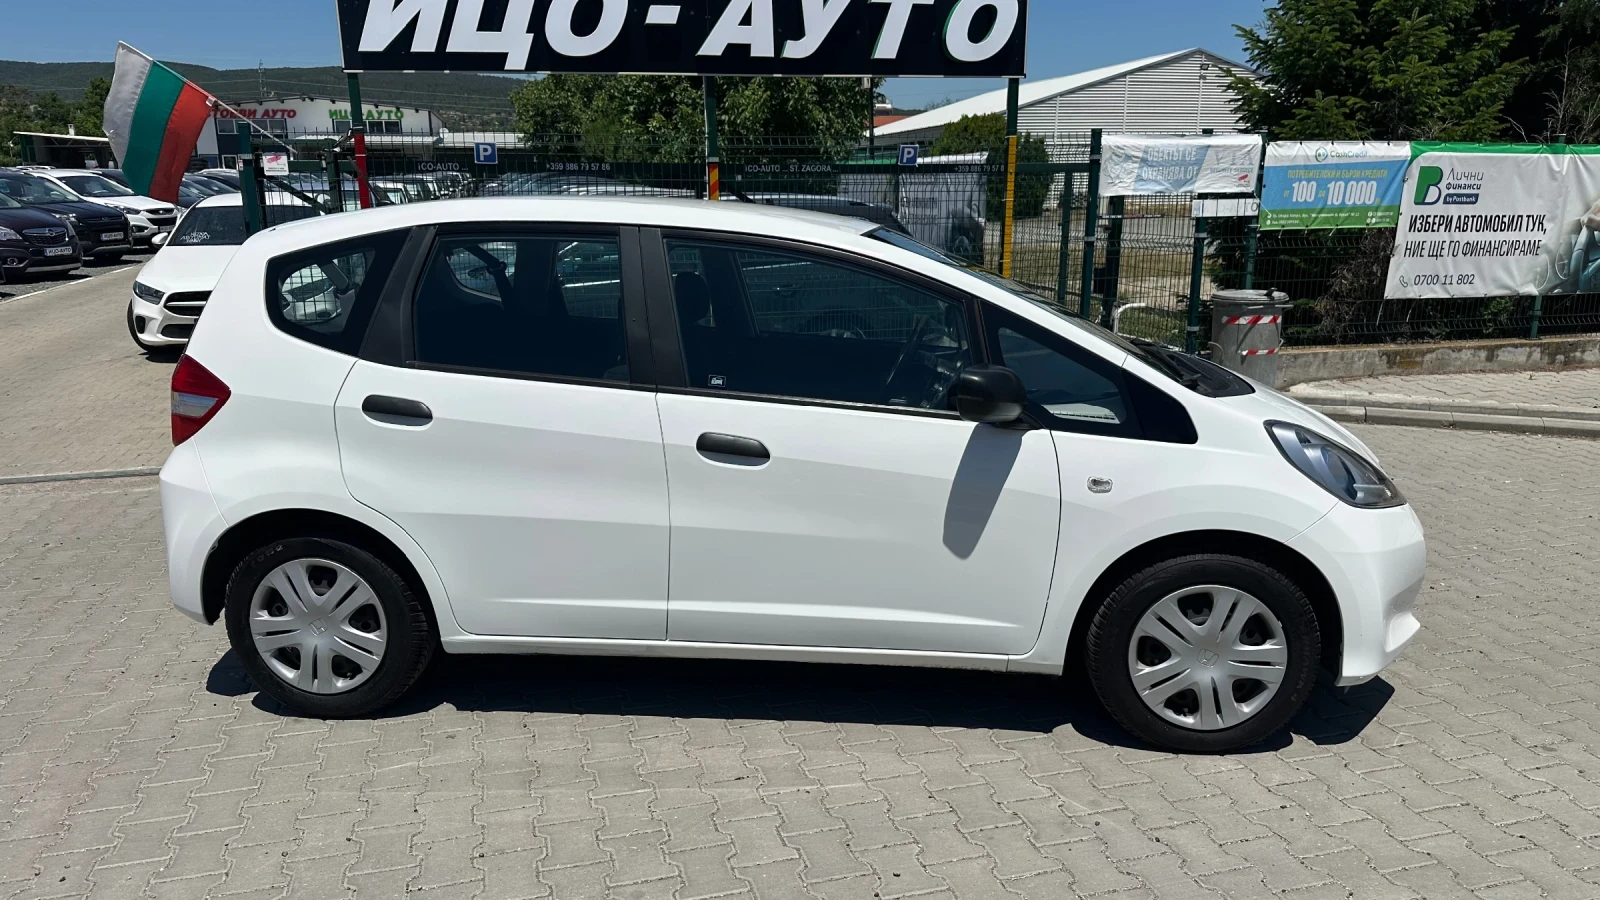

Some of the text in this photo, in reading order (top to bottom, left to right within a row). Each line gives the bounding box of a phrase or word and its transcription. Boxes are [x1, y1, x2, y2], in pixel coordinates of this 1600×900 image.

[209, 108, 296, 118] ТОЕВИ АУТО
[1330, 150, 1368, 158] CashCredit
[801, 164, 831, 172] ZAGORA
[1447, 168, 1484, 181] Лични
[1292, 181, 1317, 202] 100
[1445, 182, 1482, 190] Финанси
[1408, 214, 1547, 235] ИЗБЕРИ АВТОМОБИЛ ТУК,
[1403, 240, 1542, 260] НИЕ ЩЕ ГО ФИНАНСИРАМЕ
[1413, 274, 1475, 285] 0700 11 802
